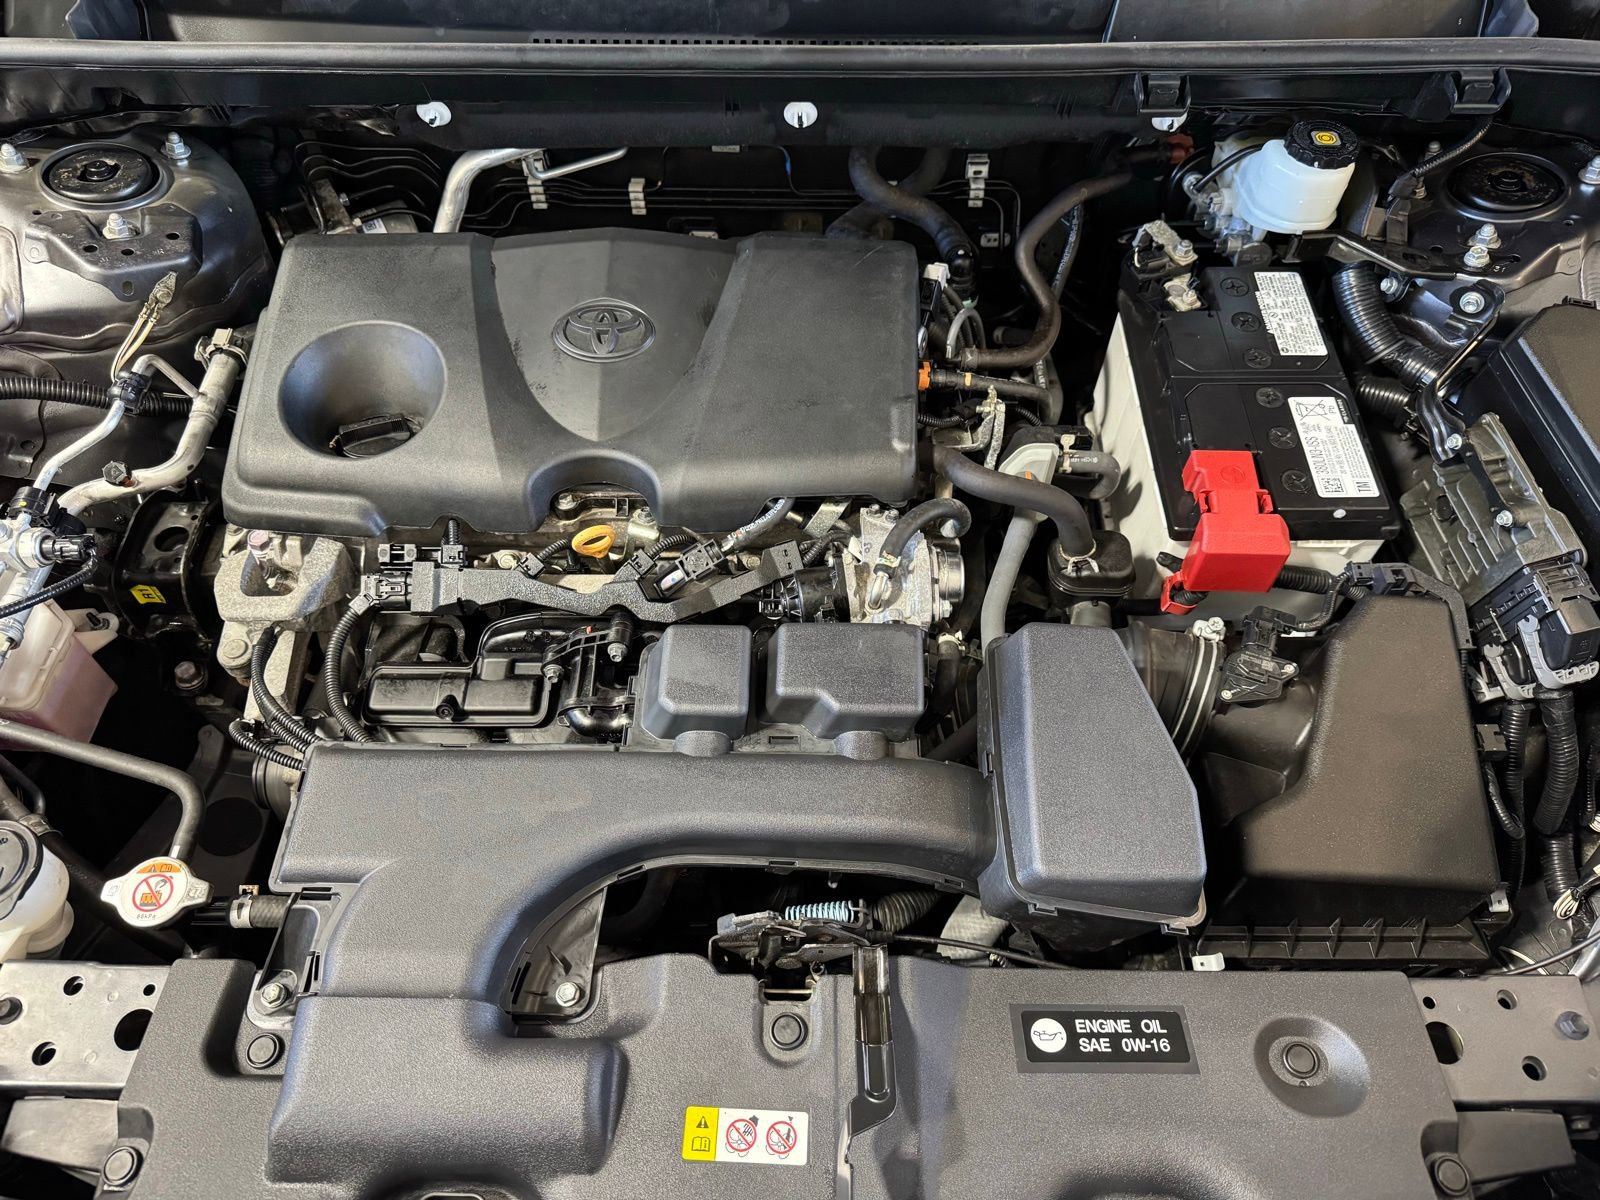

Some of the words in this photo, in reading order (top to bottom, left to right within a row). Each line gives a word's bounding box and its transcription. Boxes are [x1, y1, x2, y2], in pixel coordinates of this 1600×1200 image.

[1355, 481, 1372, 493] TM
[1074, 1019, 1132, 1033] ENGINE
[1140, 1019, 1167, 1033] OIL
[1079, 1038, 1112, 1053] SAE
[1121, 1038, 1171, 1053] 0W-16
